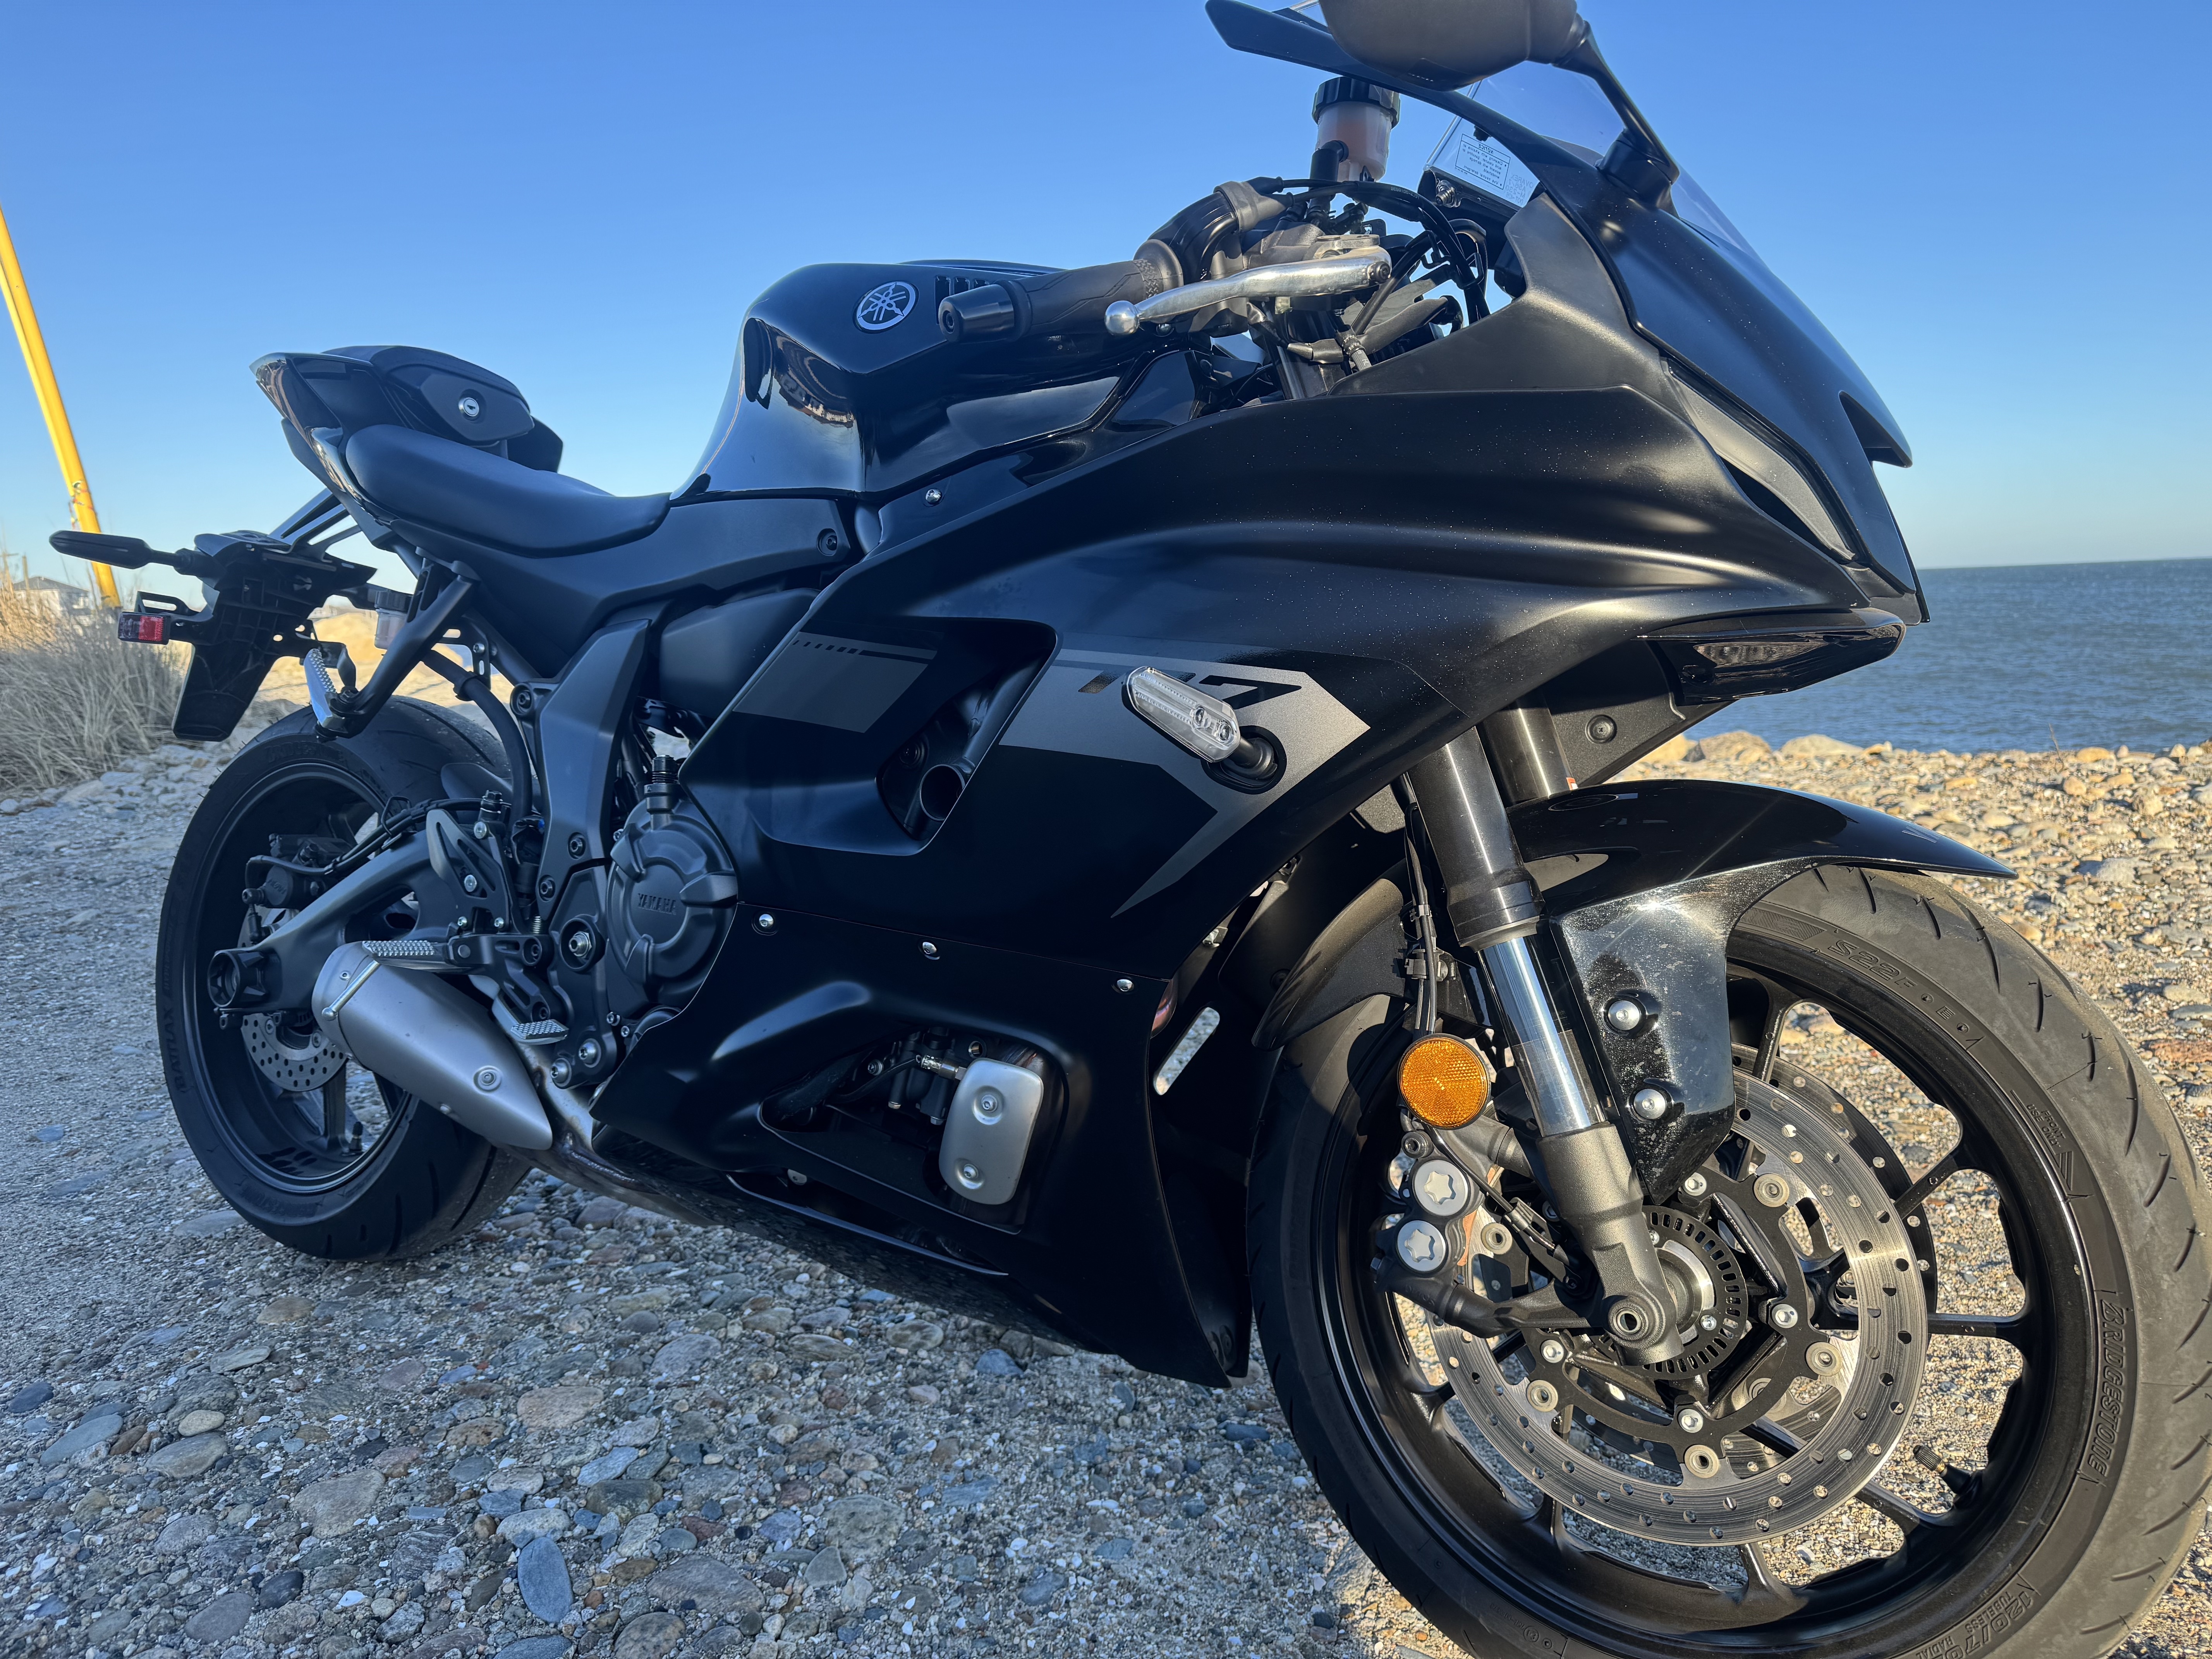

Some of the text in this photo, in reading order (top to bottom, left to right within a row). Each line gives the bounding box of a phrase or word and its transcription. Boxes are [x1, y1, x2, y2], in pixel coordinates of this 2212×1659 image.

[638, 893, 677, 915] YAMAHA
[1827, 939, 1901, 981] S22
[2027, 1104, 2061, 1147] USE ONLY
[2041, 1110, 2066, 1139] FRONT
[2088, 1299, 2125, 1477] BRIDGESTONE
[1932, 1591, 2034, 1659] 120/70
[1965, 1591, 2014, 1633] TUBELESS
[1915, 1636, 1955, 1659] RADIAL
